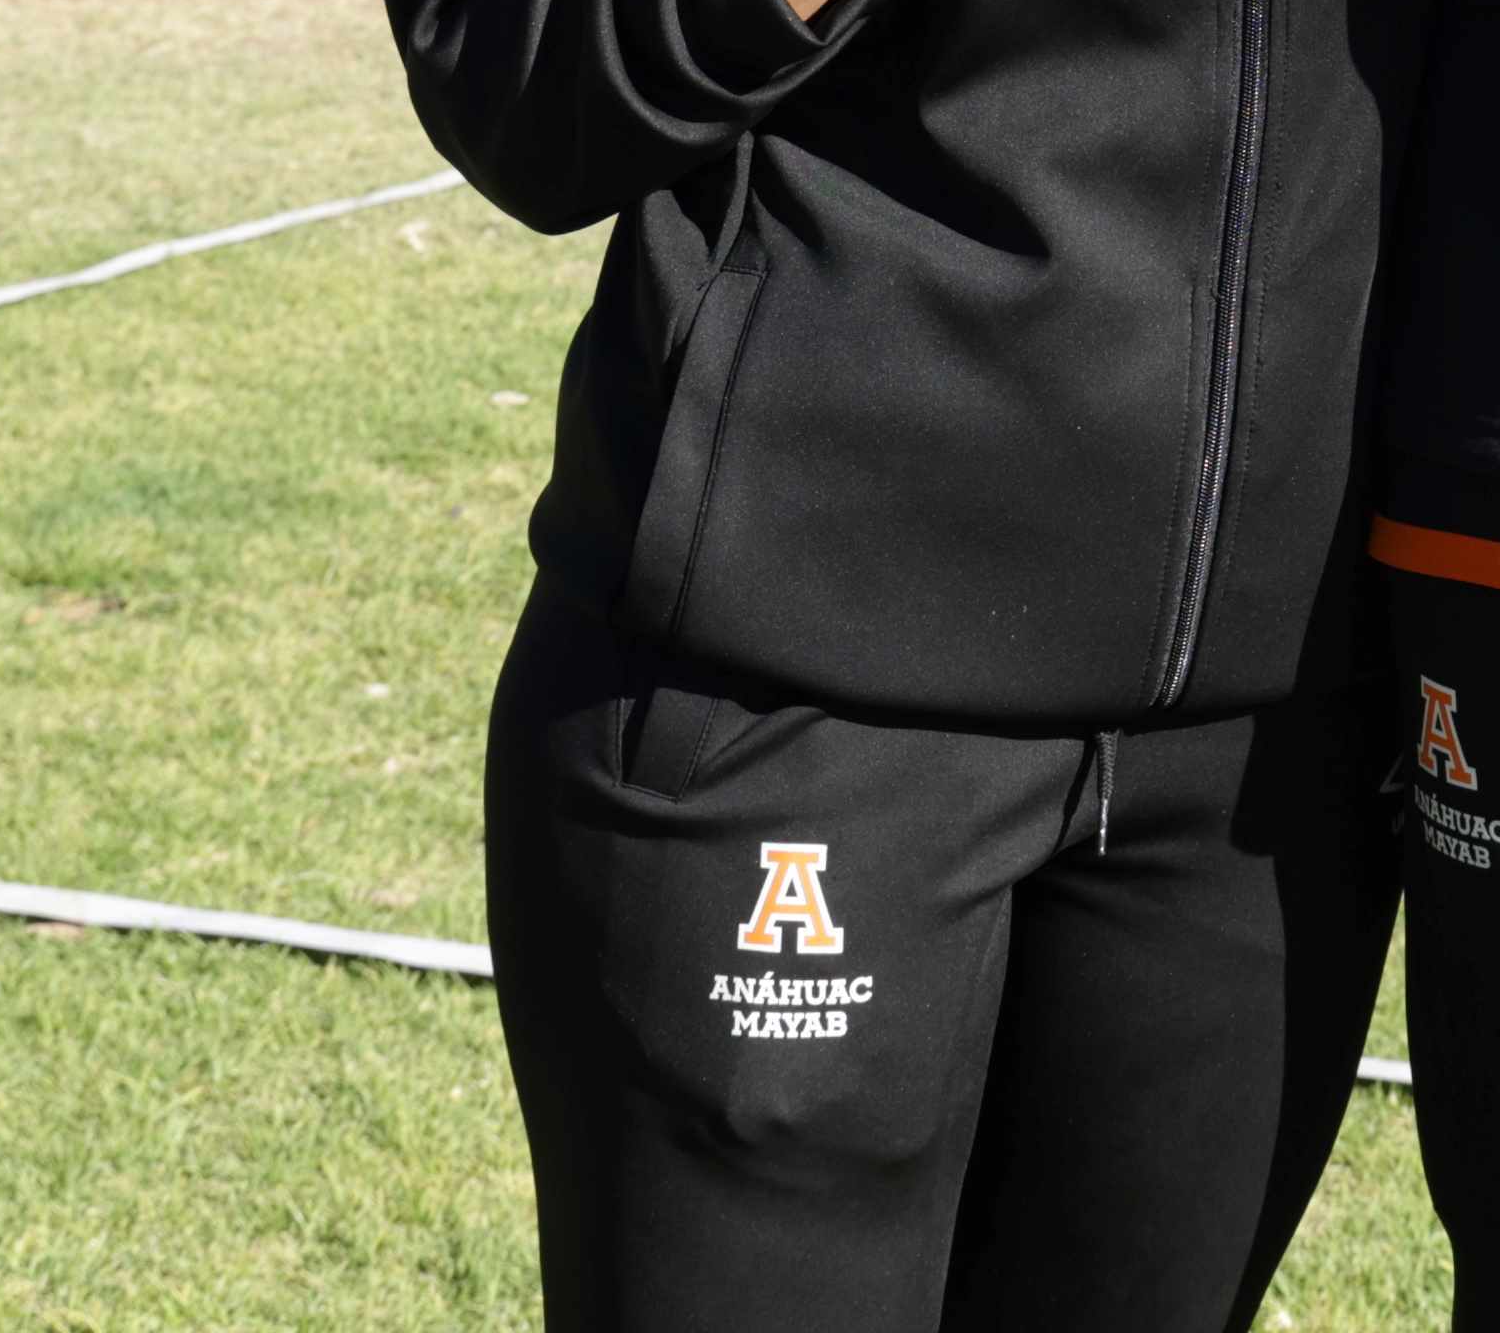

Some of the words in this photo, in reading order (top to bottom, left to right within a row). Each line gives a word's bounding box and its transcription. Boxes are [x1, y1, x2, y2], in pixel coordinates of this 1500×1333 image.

[1416, 673, 1479, 791] A
[1422, 819, 1492, 870] MAYAB
[736, 841, 844, 954] A
[709, 970, 874, 1006] ANÁHUAC
[731, 1009, 849, 1039] MAYAB
